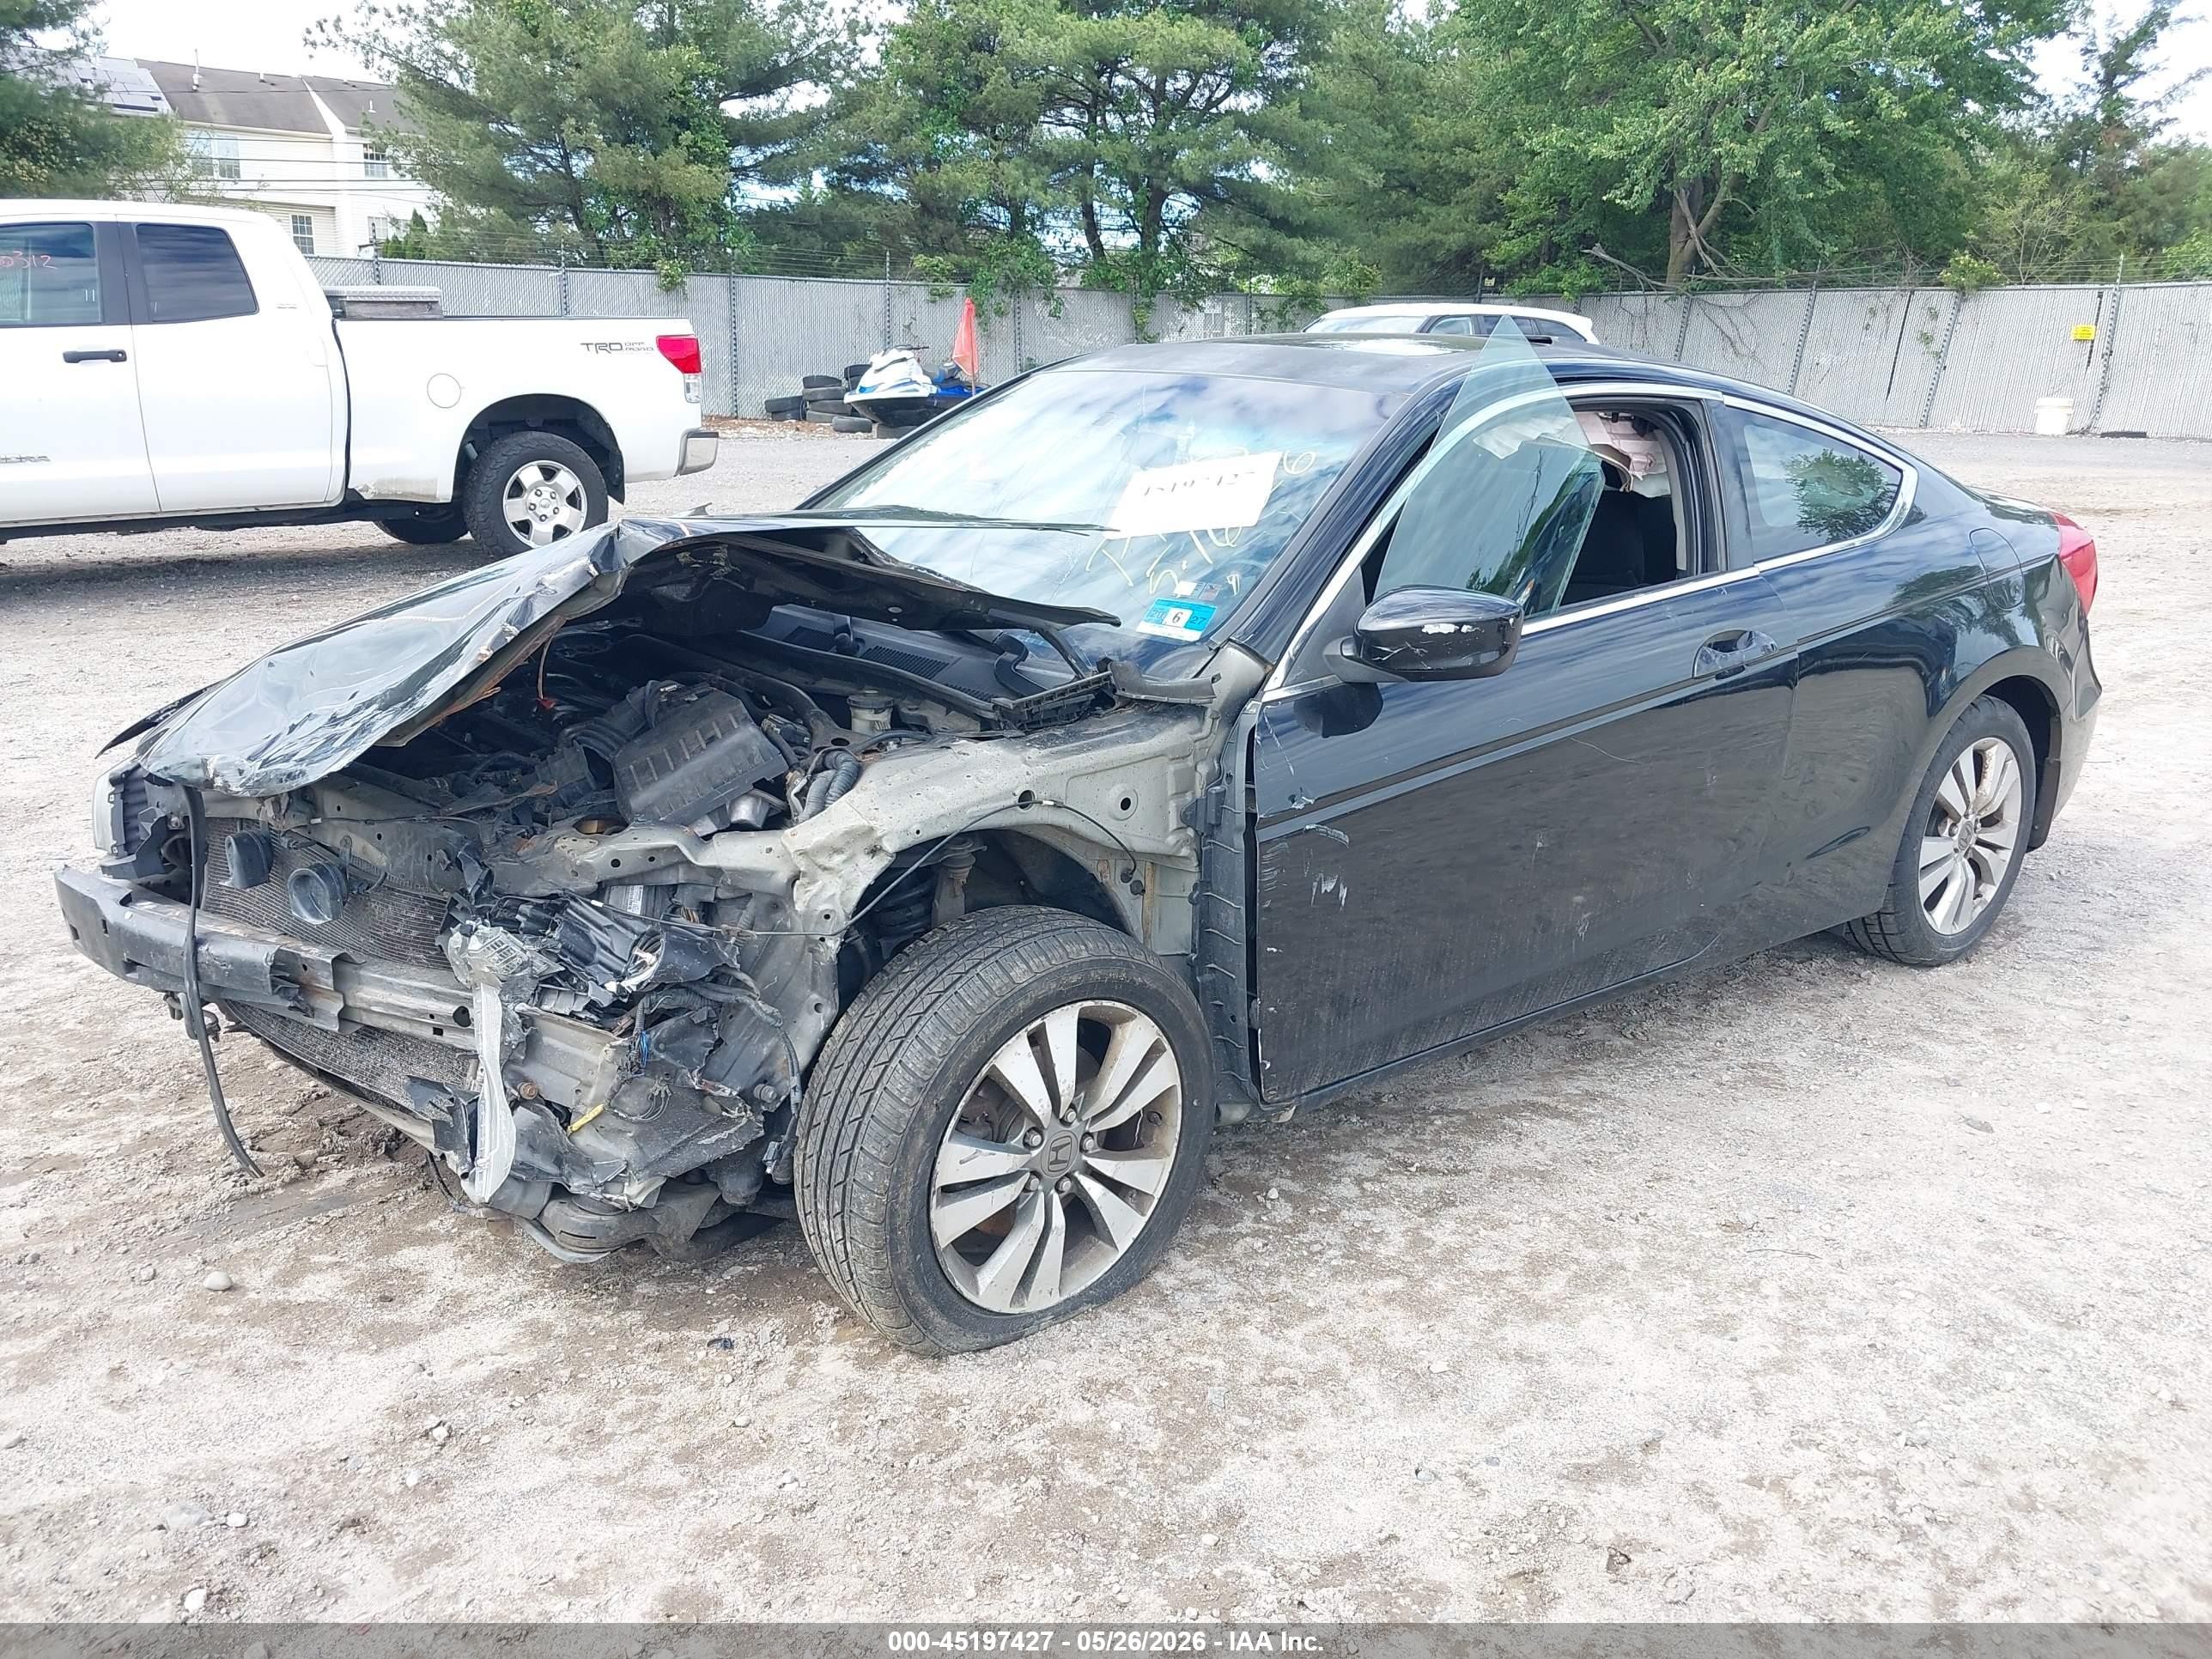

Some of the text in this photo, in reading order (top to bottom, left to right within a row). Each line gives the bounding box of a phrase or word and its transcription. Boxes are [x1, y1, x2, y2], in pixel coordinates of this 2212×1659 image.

[580, 342, 623, 354] TRD
[1171, 611, 1183, 624] 6
[1189, 616, 1208, 626] 27
